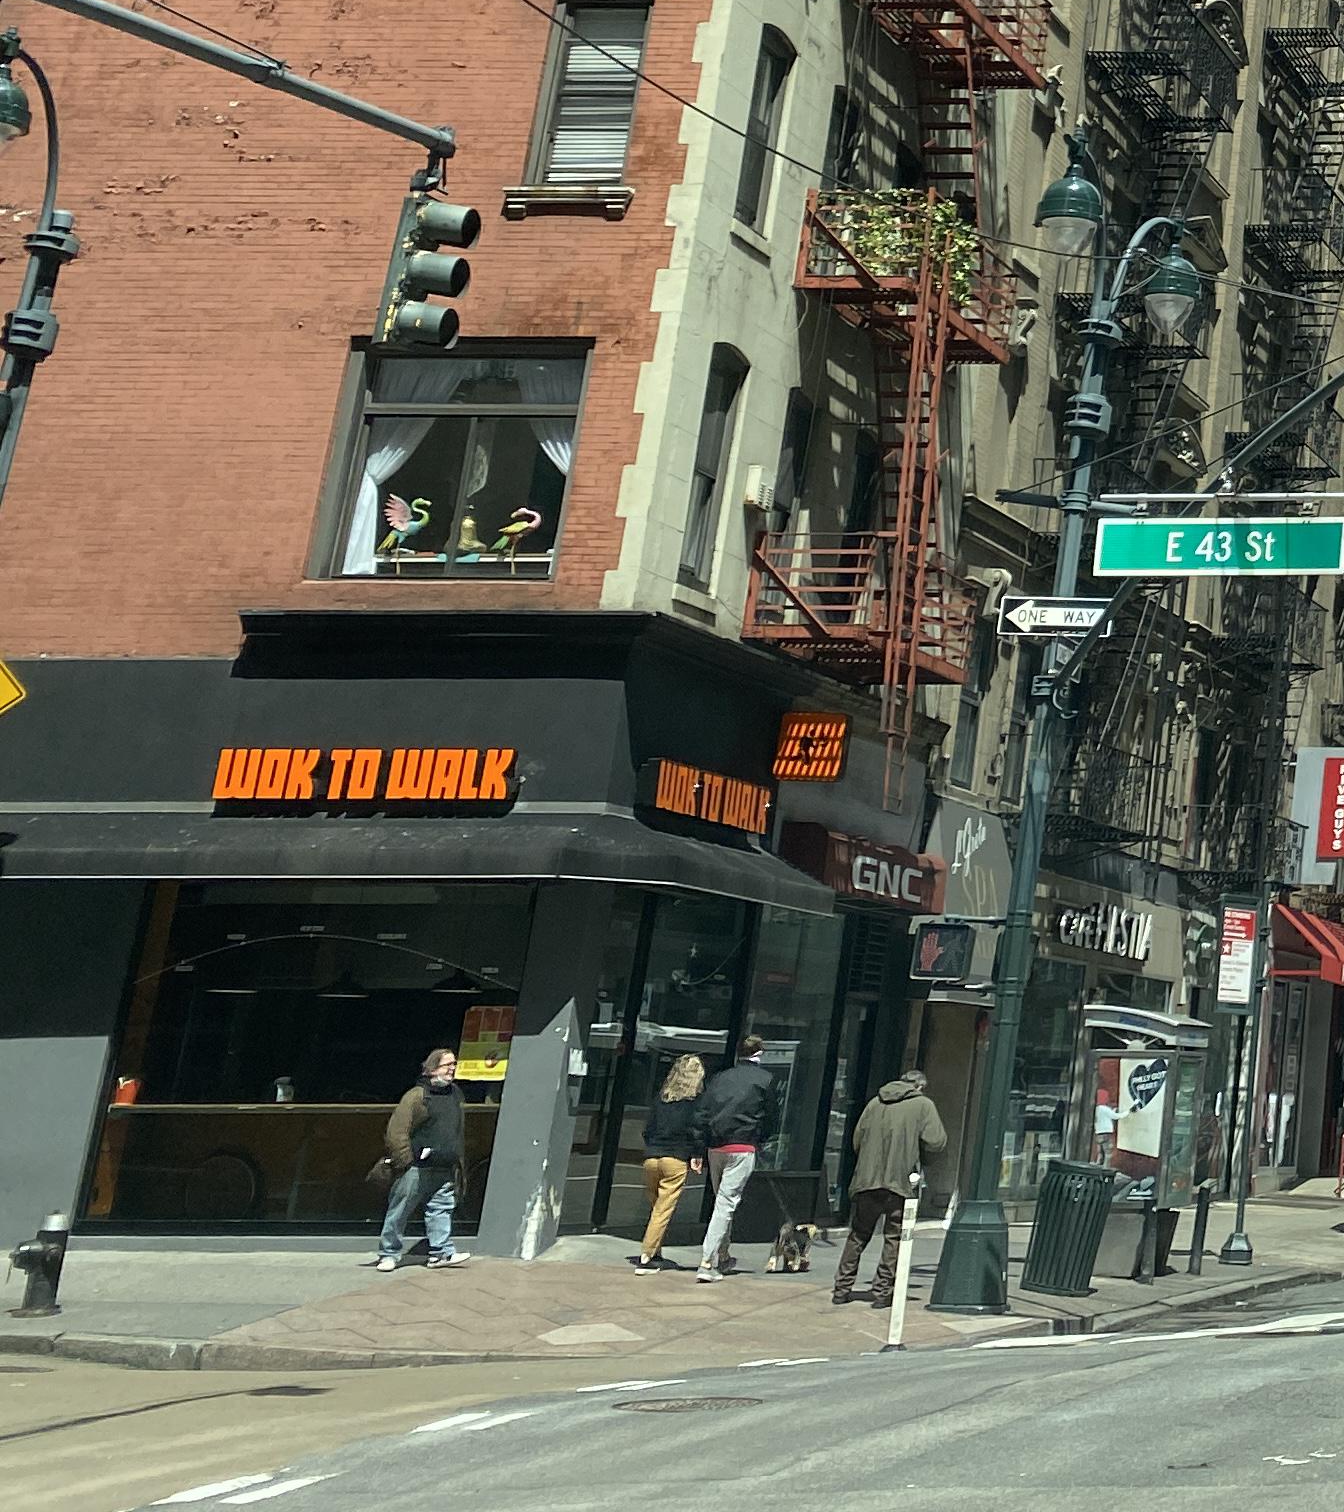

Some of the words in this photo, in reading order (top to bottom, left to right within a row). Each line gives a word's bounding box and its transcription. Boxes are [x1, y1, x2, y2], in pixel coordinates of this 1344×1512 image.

[1165, 531, 1184, 563] E
[1195, 531, 1232, 563] 43
[1244, 531, 1276, 563] St
[1016, 608, 1047, 624] ONE
[1063, 608, 1097, 624] WAY
[212, 748, 321, 800] WOK
[327, 748, 383, 800] TO
[385, 748, 514, 800] WALK
[655, 759, 699, 817] WOK
[701, 771, 725, 823] TO
[722, 777, 771, 835] WALK
[852, 855, 923, 904] GNC
